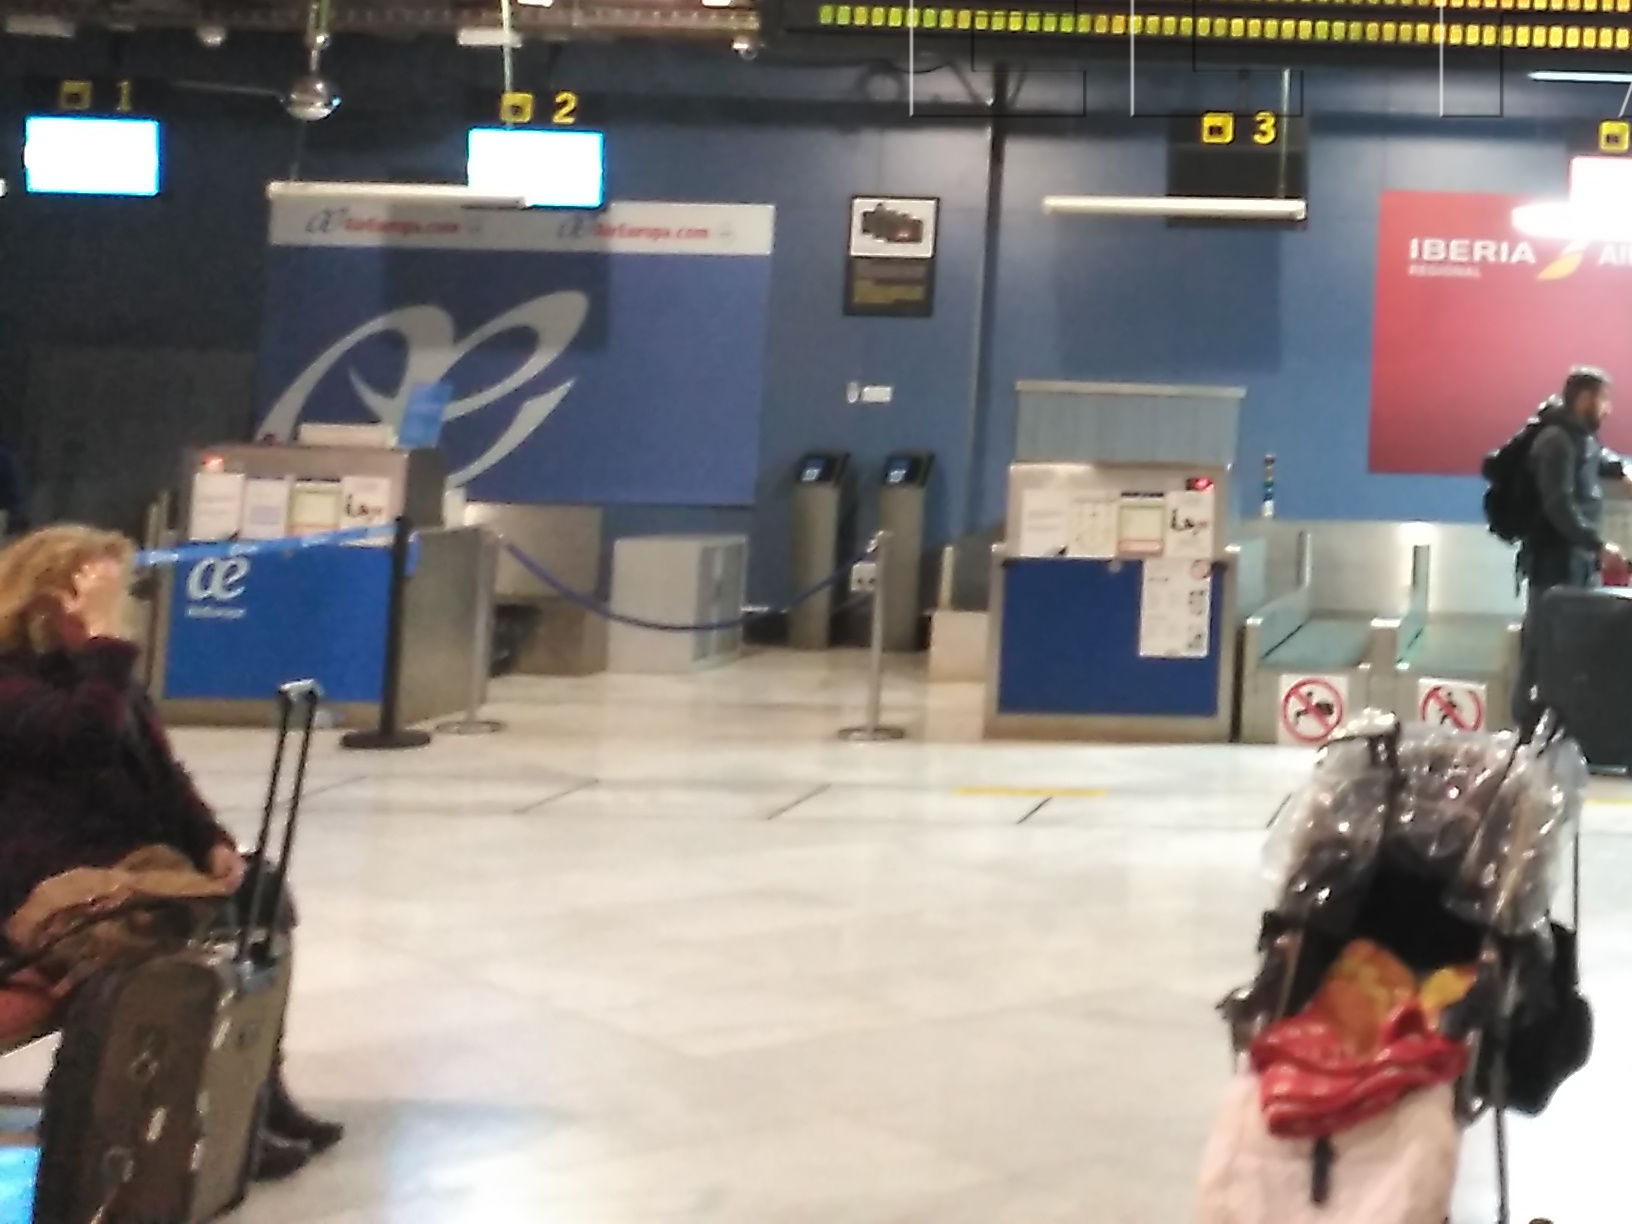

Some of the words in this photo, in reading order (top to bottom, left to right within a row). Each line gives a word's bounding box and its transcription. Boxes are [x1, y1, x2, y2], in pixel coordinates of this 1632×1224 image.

[116, 79, 131, 112] 1
[552, 93, 577, 124] 2
[1252, 111, 1278, 144] 3
[1408, 237, 1537, 265] IBERIA
